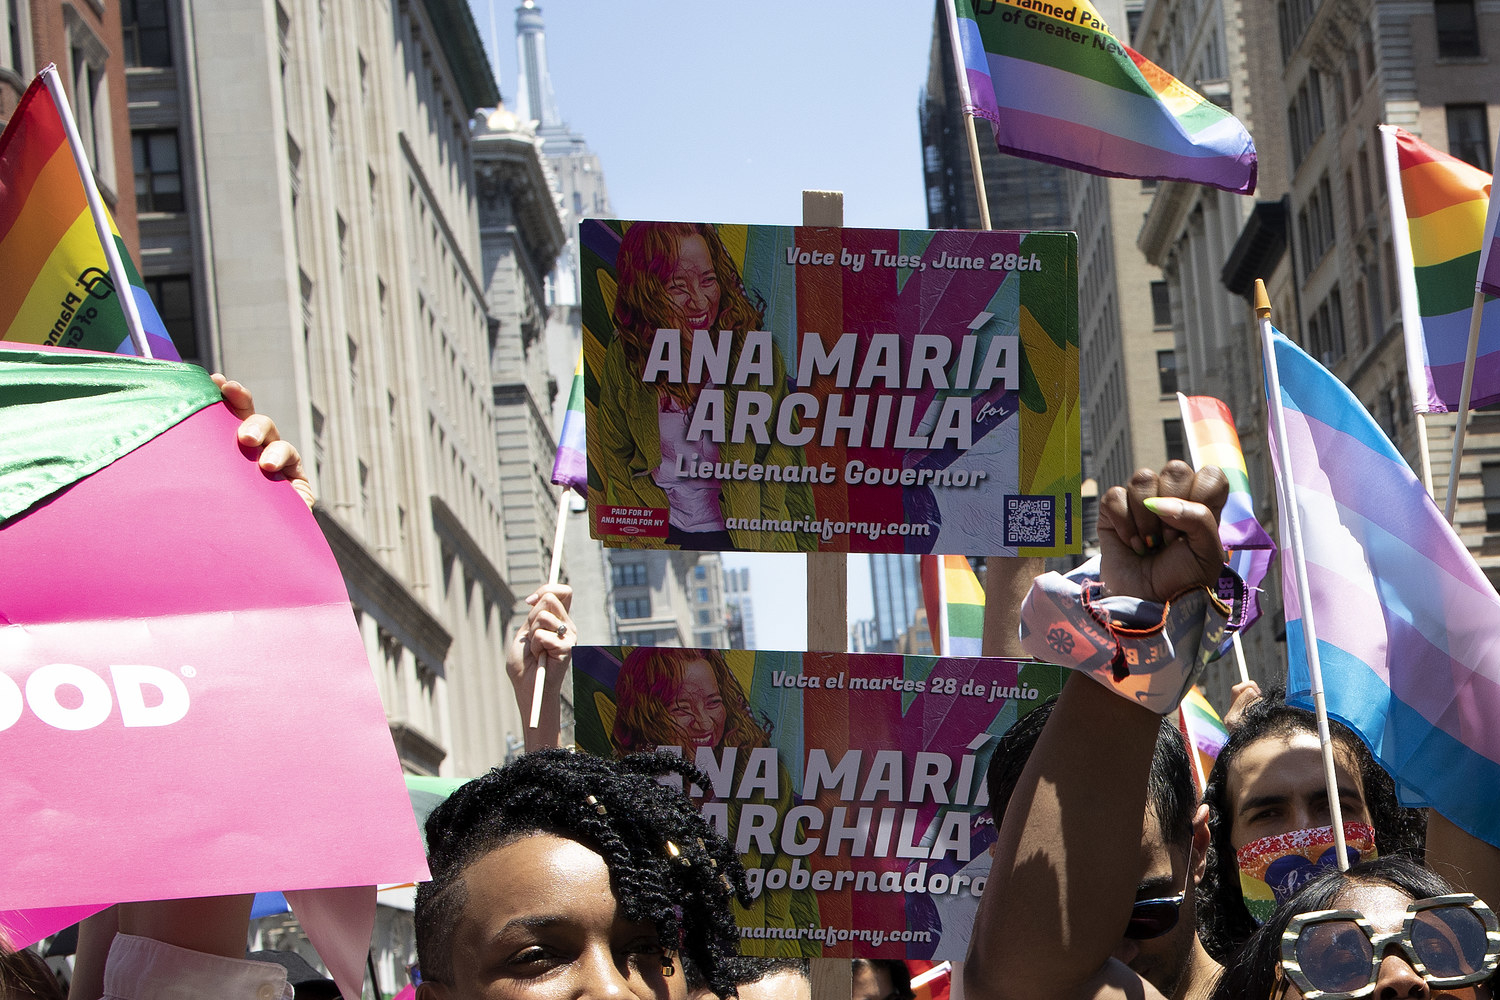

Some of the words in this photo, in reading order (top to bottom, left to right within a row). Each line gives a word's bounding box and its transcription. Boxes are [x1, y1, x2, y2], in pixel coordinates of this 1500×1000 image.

[1002, 10, 1021, 24] of
[1025, 13, 1089, 44] Greater
[1004, 0, 1077, 21] anned
[1080, 11, 1114, 35] Par
[786, 246, 834, 267] Vote
[841, 248, 865, 271] by
[871, 249, 927, 271] Tues,
[932, 251, 985, 271] June
[990, 252, 1041, 272] 28th
[642, 329, 774, 386] ANA
[799, 312, 1019, 389] MARÍA
[686, 390, 972, 449] ARCHILA
[976, 402, 1009, 423] for
[675, 453, 836, 483] Lieutenant
[844, 460, 986, 488] Governor
[616, 517, 638, 525] MARIA
[725, 515, 931, 541] anamariaforny.com
[772, 670, 820, 689] Vota
[826, 672, 844, 689] el
[849, 675, 926, 692] martes
[932, 678, 957, 694] 28
[961, 679, 985, 697] de
[987, 682, 1039, 702] junio
[802, 733, 990, 806] MARÍ
